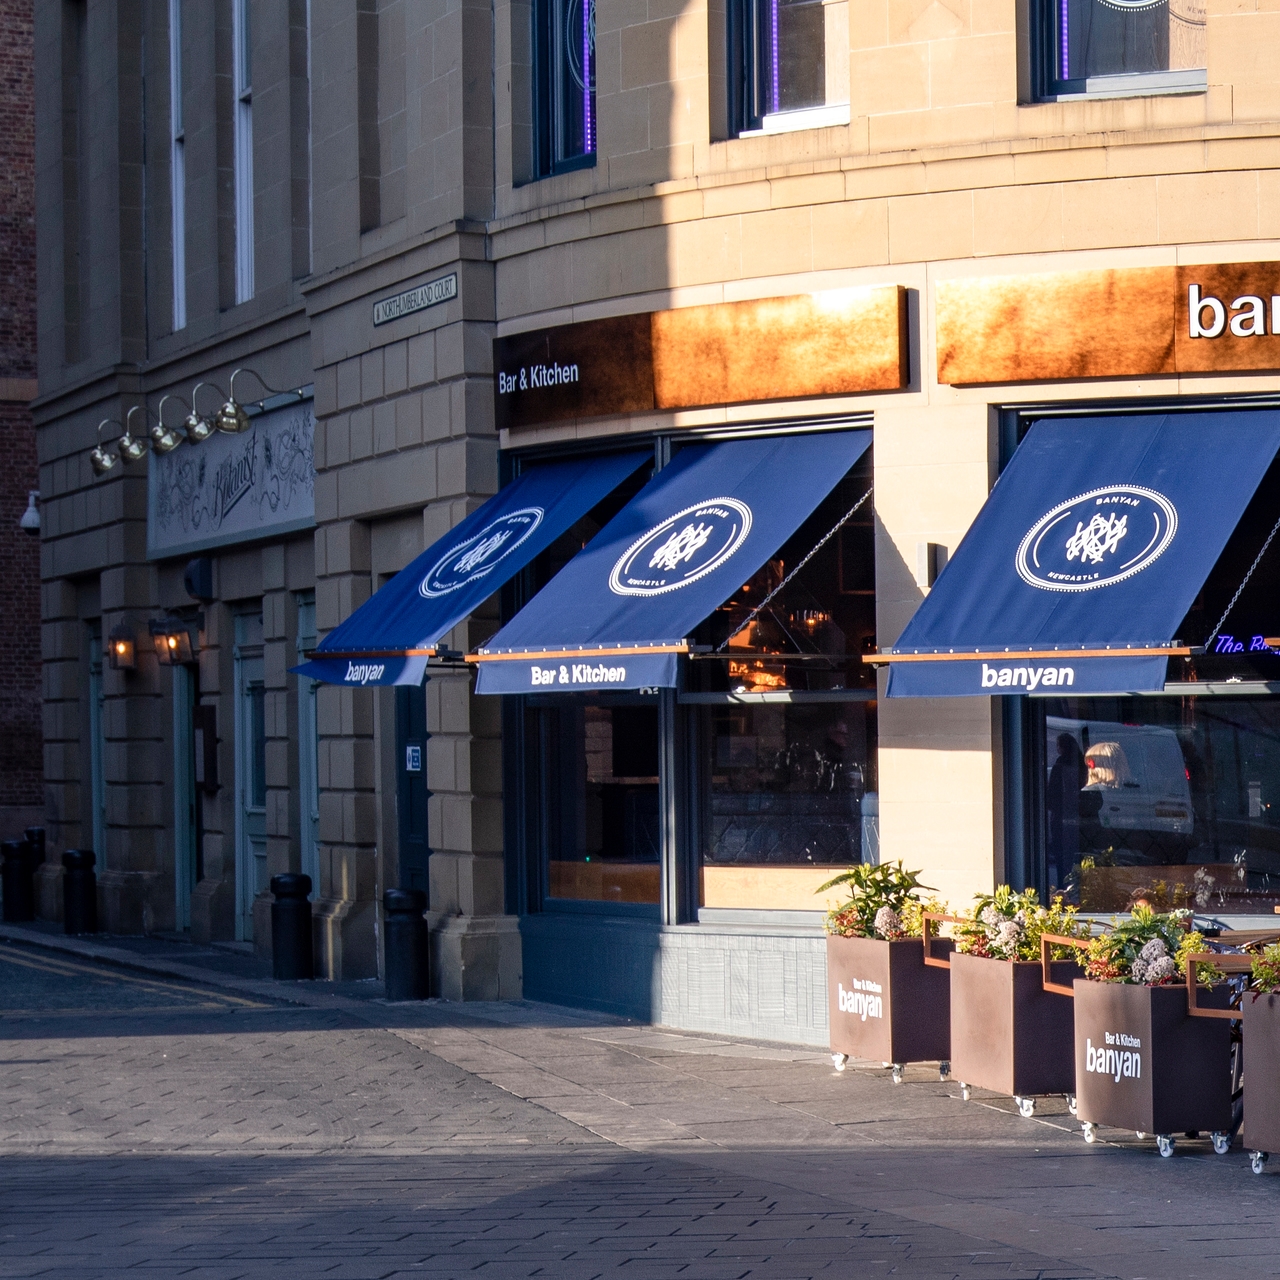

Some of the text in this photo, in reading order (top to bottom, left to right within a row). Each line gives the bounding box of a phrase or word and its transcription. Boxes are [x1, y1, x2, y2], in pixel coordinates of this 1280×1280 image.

[382, 278, 453, 318] NORTHUMBERLAND COURT
[499, 362, 579, 394] Bar & Kitchen
[1095, 496, 1141, 507] BANYAN
[1047, 571, 1099, 581] NEWCASTLE
[344, 661, 384, 685] banyan
[531, 663, 626, 685] Bar & Kitchen
[981, 663, 1075, 691] banyan
[838, 983, 882, 1022] banyan
[1105, 1031, 1141, 1048] Bar & Kitchen
[1086, 1038, 1141, 1083] banyan
